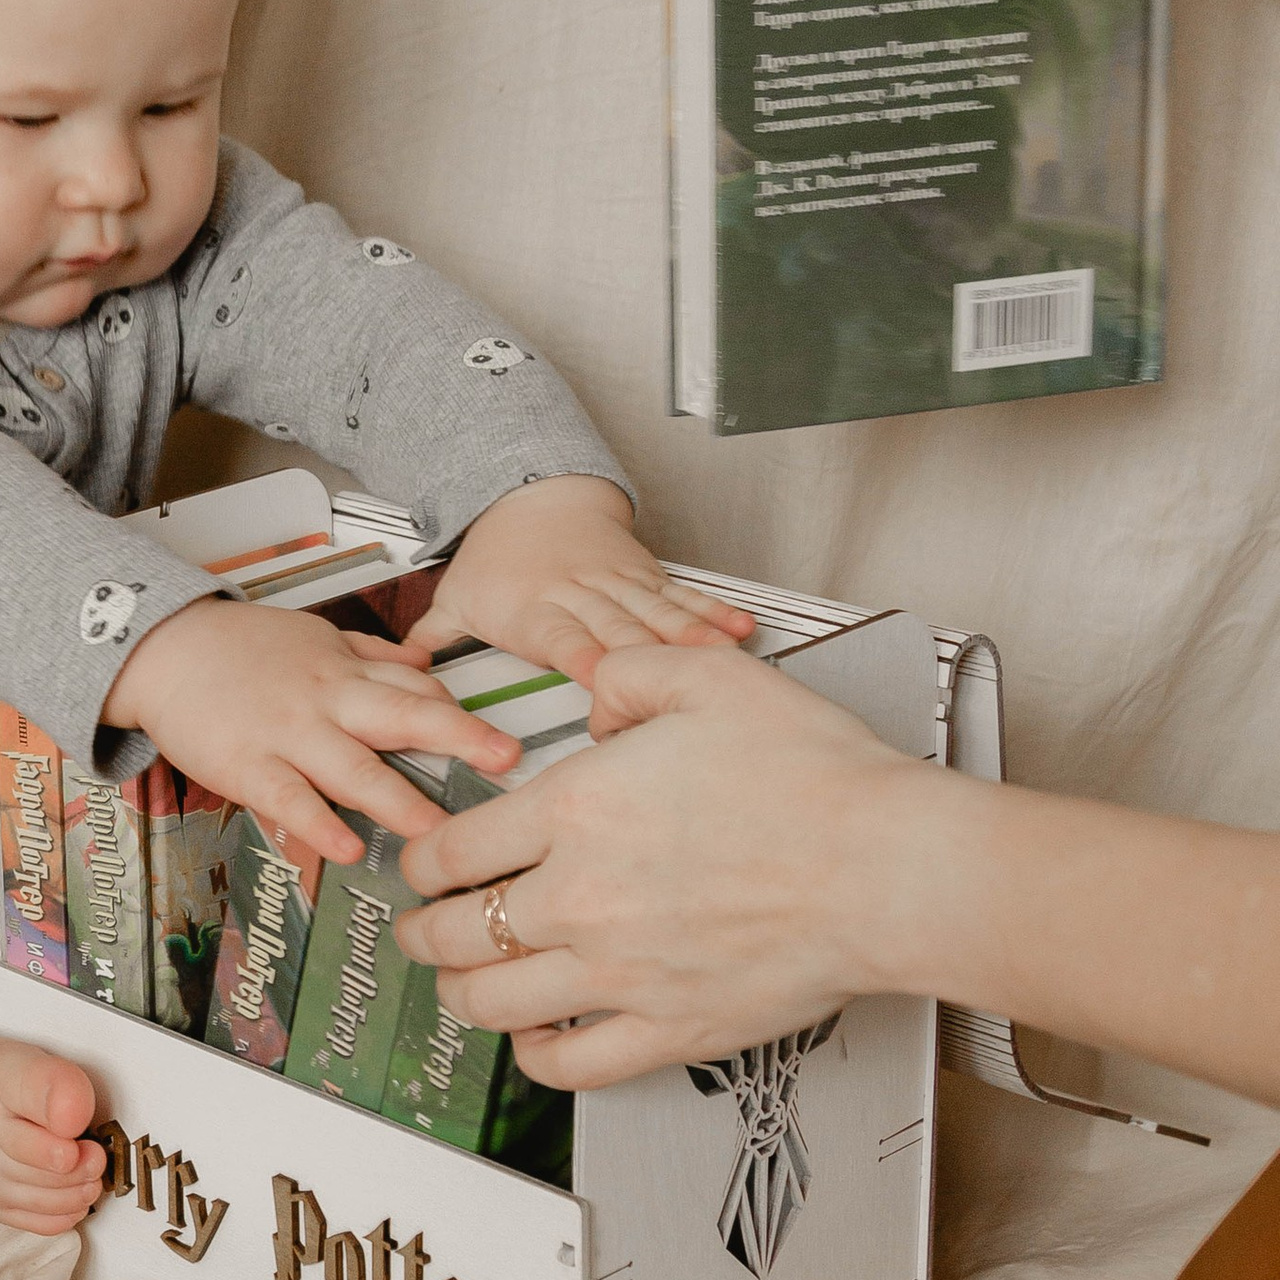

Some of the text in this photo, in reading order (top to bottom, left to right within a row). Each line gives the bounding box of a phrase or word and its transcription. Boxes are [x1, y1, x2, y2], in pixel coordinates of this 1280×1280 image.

[0, 751, 53, 828] Гарри
[69, 775, 122, 853] Гарри
[14, 826, 54, 922] Поттер
[88, 852, 127, 946] Поттер
[247, 845, 302, 933] Гарри
[230, 922, 287, 1021] Поттер
[326, 884, 393, 1058] Гарри Поттер
[88, 1119, 230, 1264] arry
